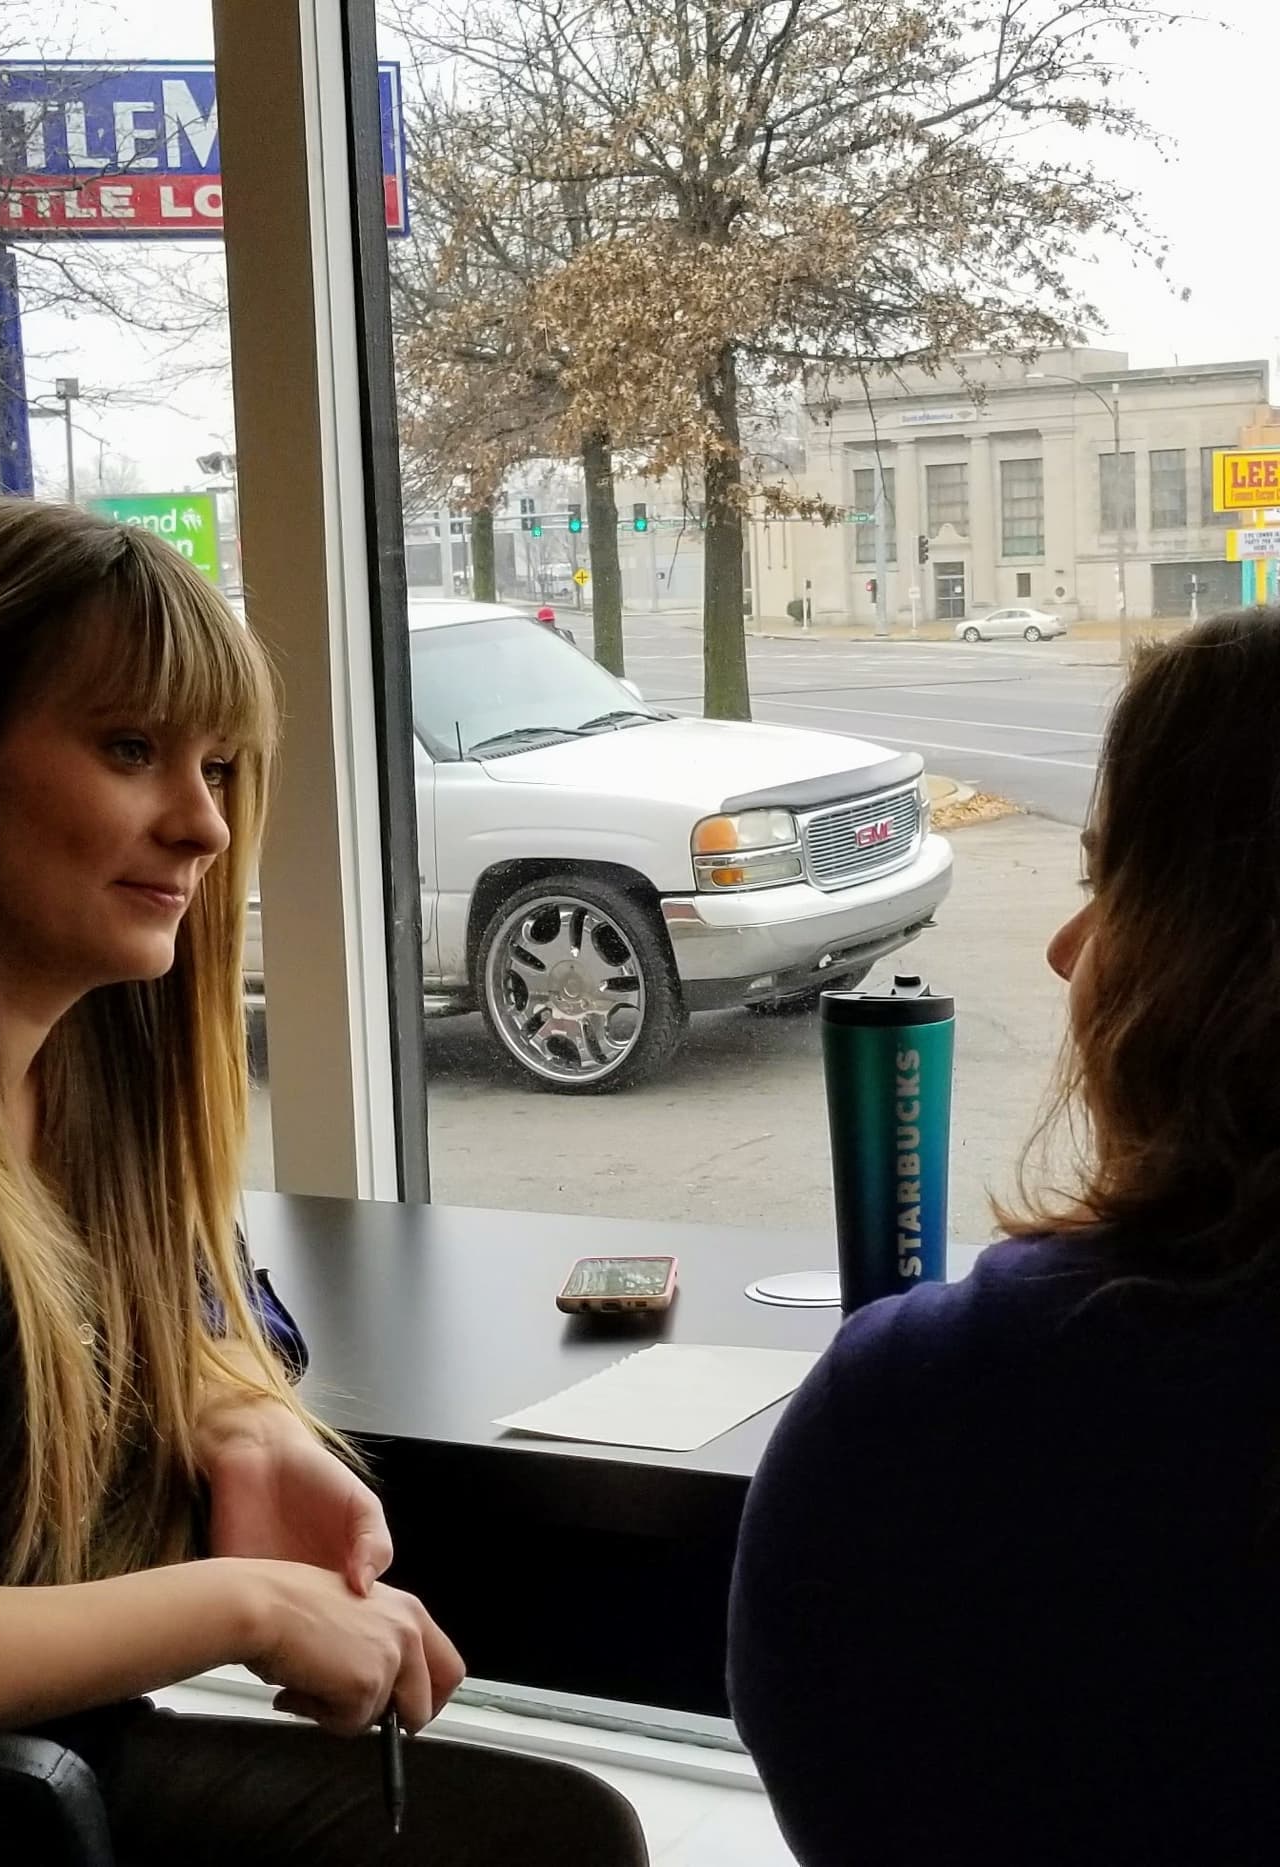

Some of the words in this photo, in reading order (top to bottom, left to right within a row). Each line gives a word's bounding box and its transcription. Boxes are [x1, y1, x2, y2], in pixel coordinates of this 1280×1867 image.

[114, 508, 177, 533] end
[856, 817, 897, 847] GMC
[896, 1049, 923, 1278] STARBUCKS
